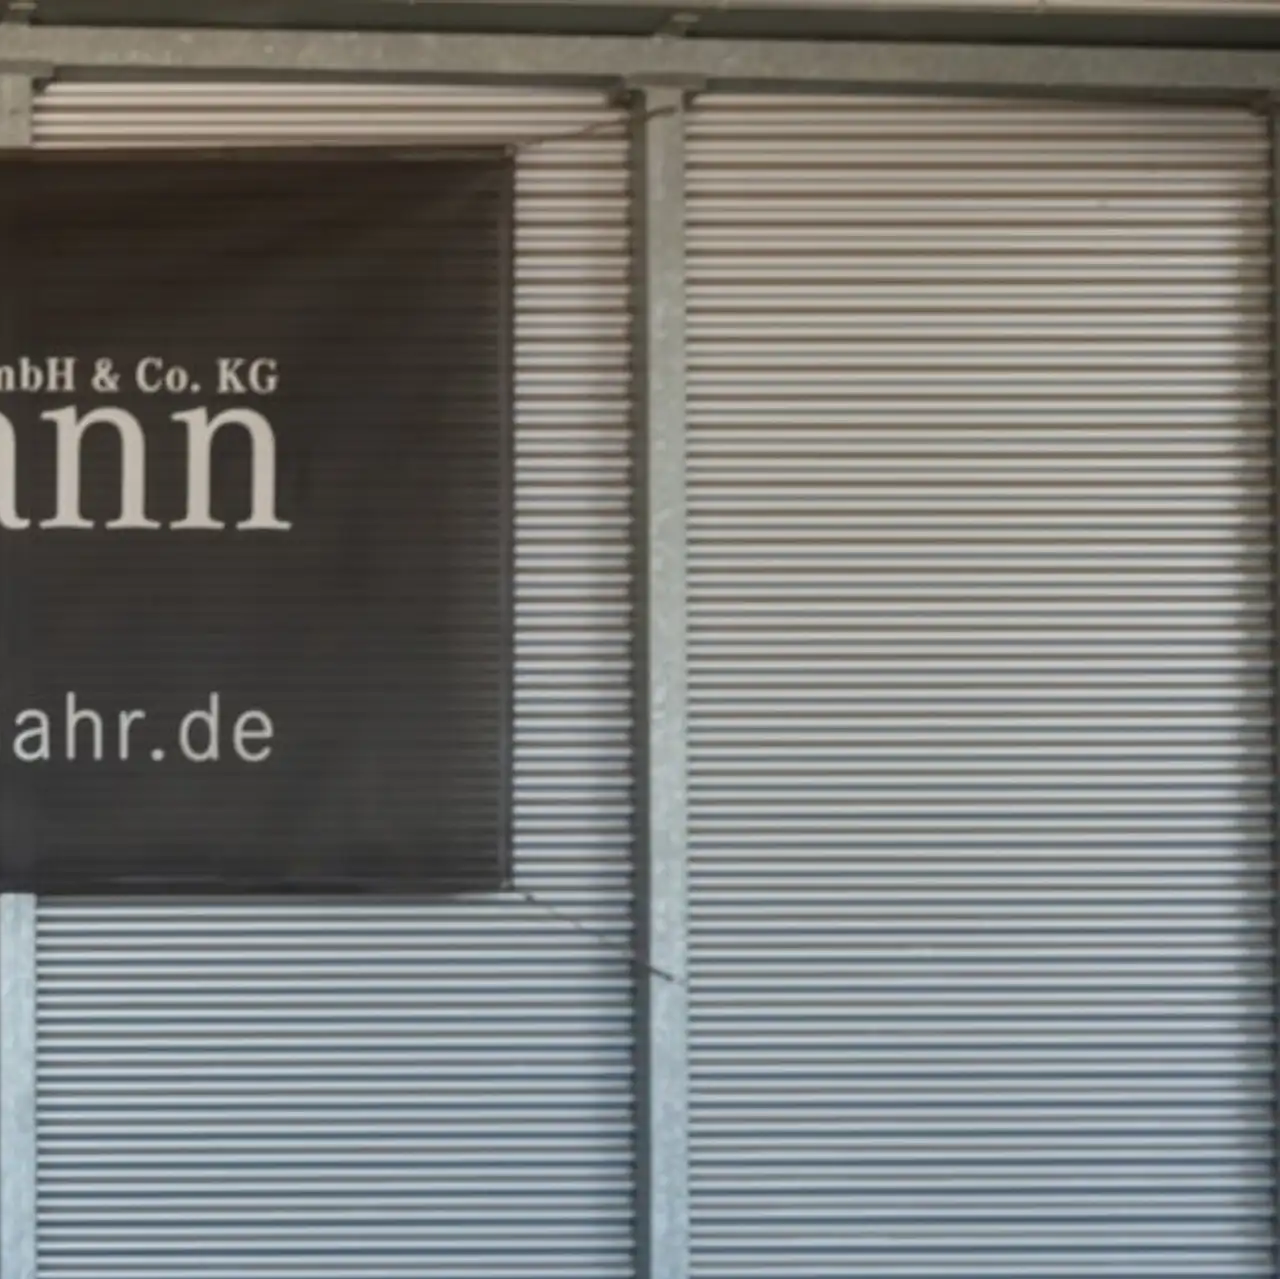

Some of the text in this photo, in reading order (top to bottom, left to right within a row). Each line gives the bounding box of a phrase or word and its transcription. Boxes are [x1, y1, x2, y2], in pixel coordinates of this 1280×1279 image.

[91, 357, 120, 392] &
[135, 357, 200, 393] Co.
[216, 358, 278, 393] KG
